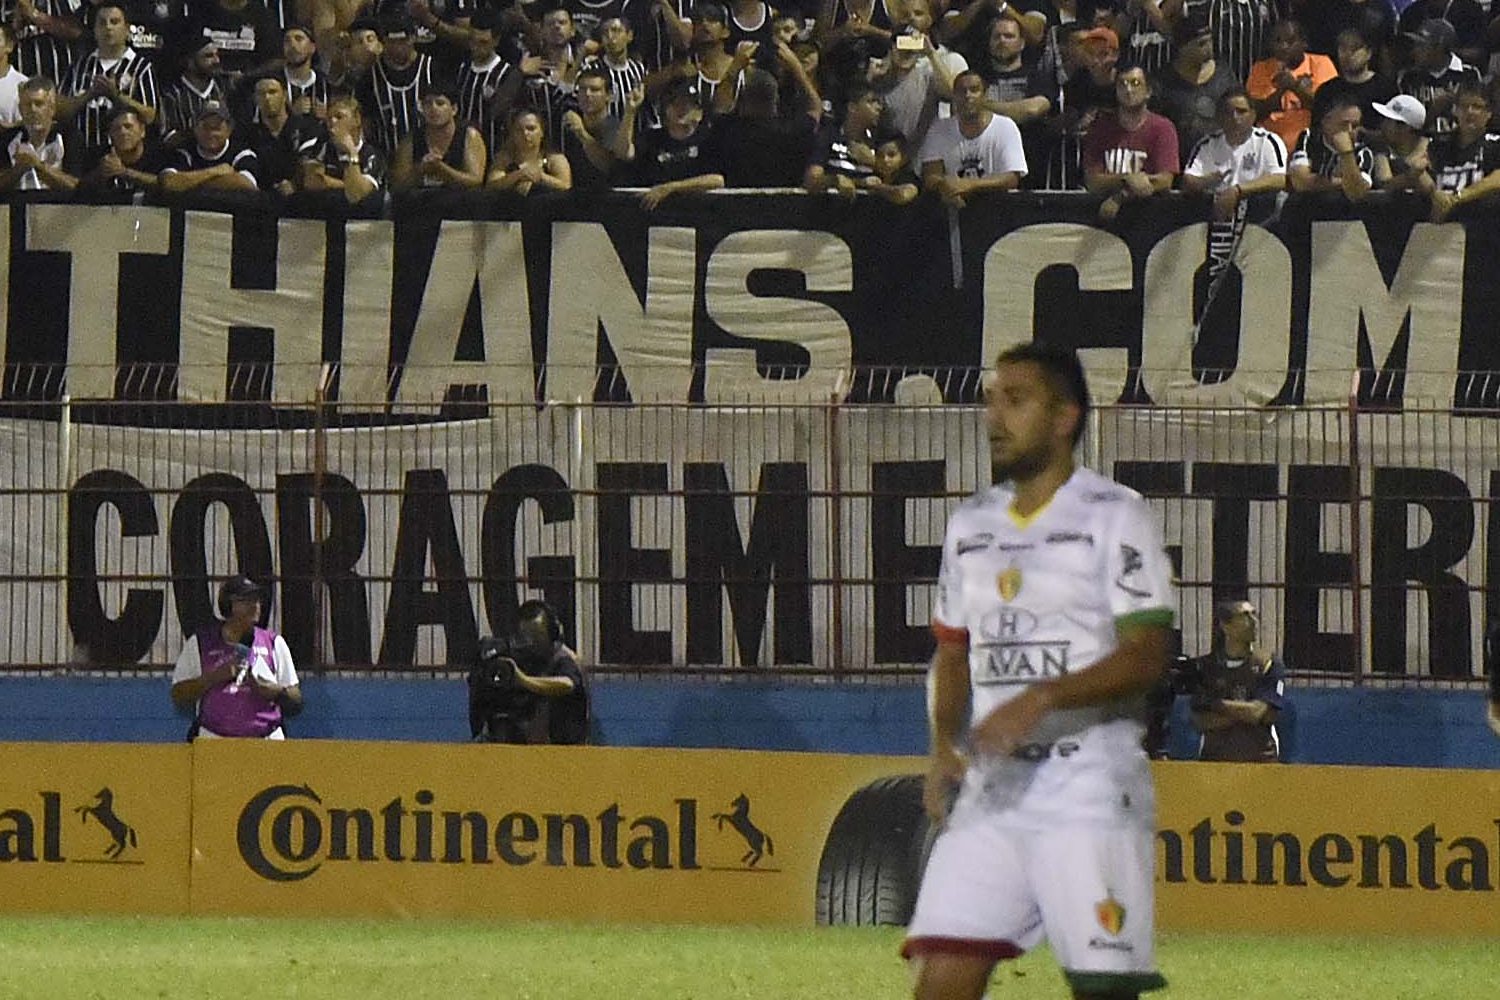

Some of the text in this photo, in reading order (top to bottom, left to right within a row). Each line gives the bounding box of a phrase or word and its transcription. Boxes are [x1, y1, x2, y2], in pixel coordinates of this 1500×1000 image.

[981, 218, 1467, 419] COM
[66, 459, 809, 668] CORAGEM
[237, 784, 702, 883] Continental
[1156, 810, 1500, 892] ntinenta
